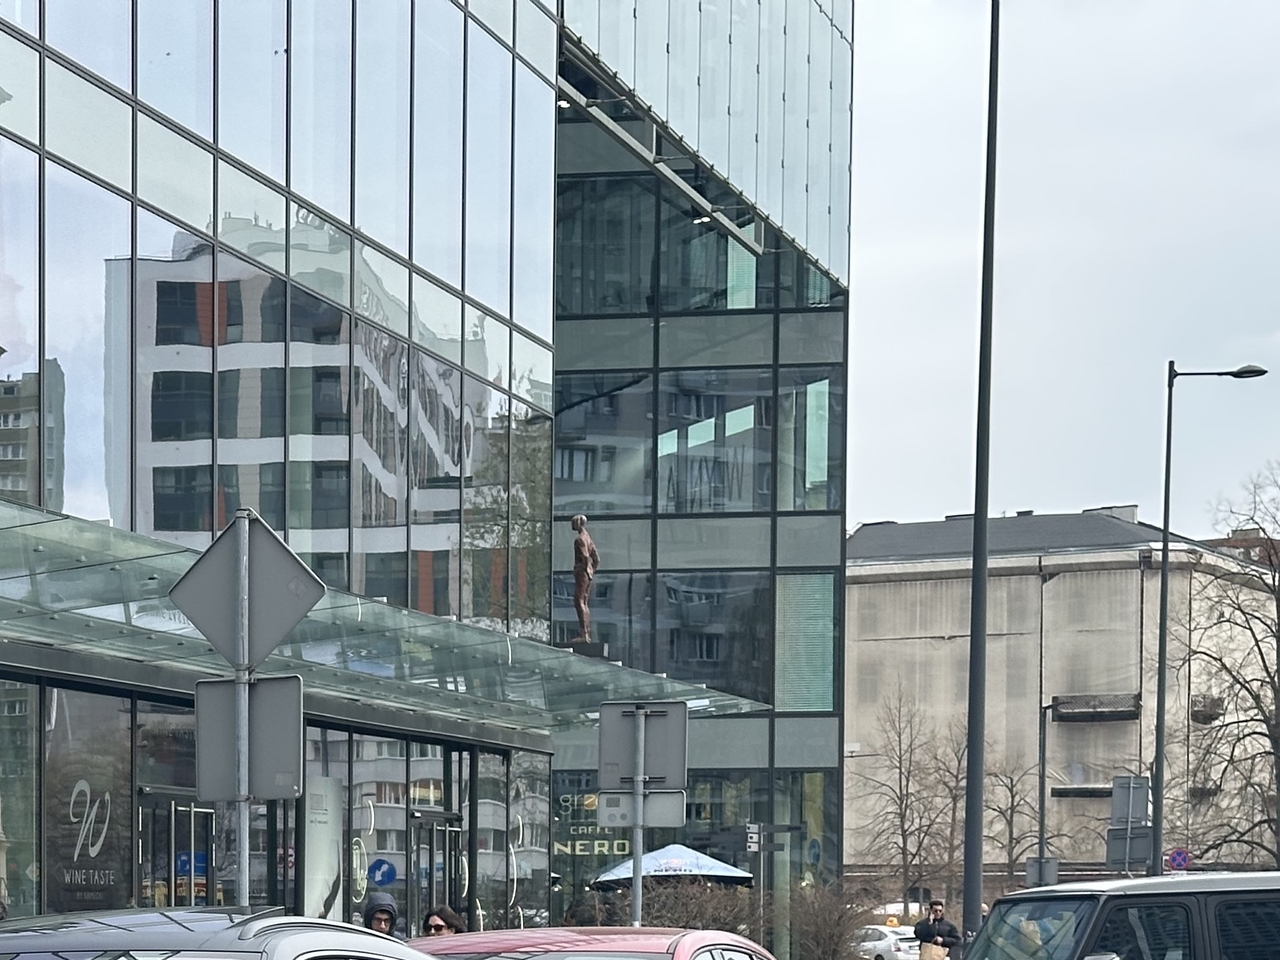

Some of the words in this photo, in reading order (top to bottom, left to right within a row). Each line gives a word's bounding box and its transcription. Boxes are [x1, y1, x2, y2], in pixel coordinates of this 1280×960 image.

[553, 840, 630, 855] NERO
[64, 869, 87, 885] WINE
[89, 870, 115, 885] TASTE
